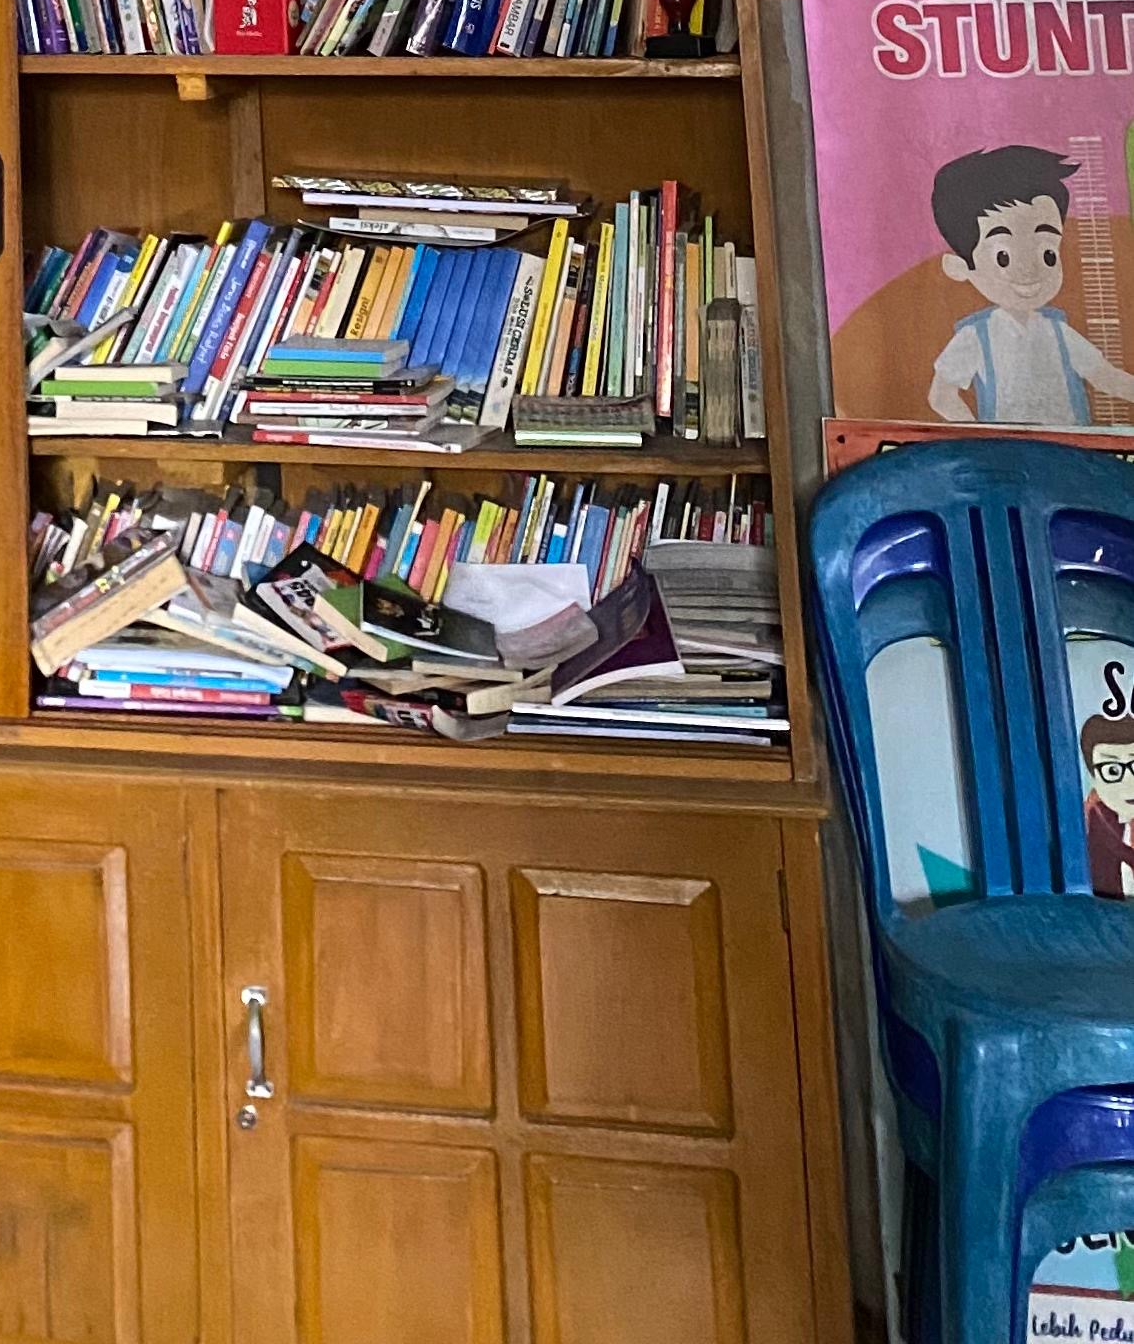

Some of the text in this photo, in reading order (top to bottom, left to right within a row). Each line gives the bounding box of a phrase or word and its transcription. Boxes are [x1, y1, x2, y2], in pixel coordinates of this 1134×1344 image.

[872, 0, 1134, 79] STUNT
[1103, 661, 1134, 718] S
[1032, 1311, 1082, 1338] Lebih
